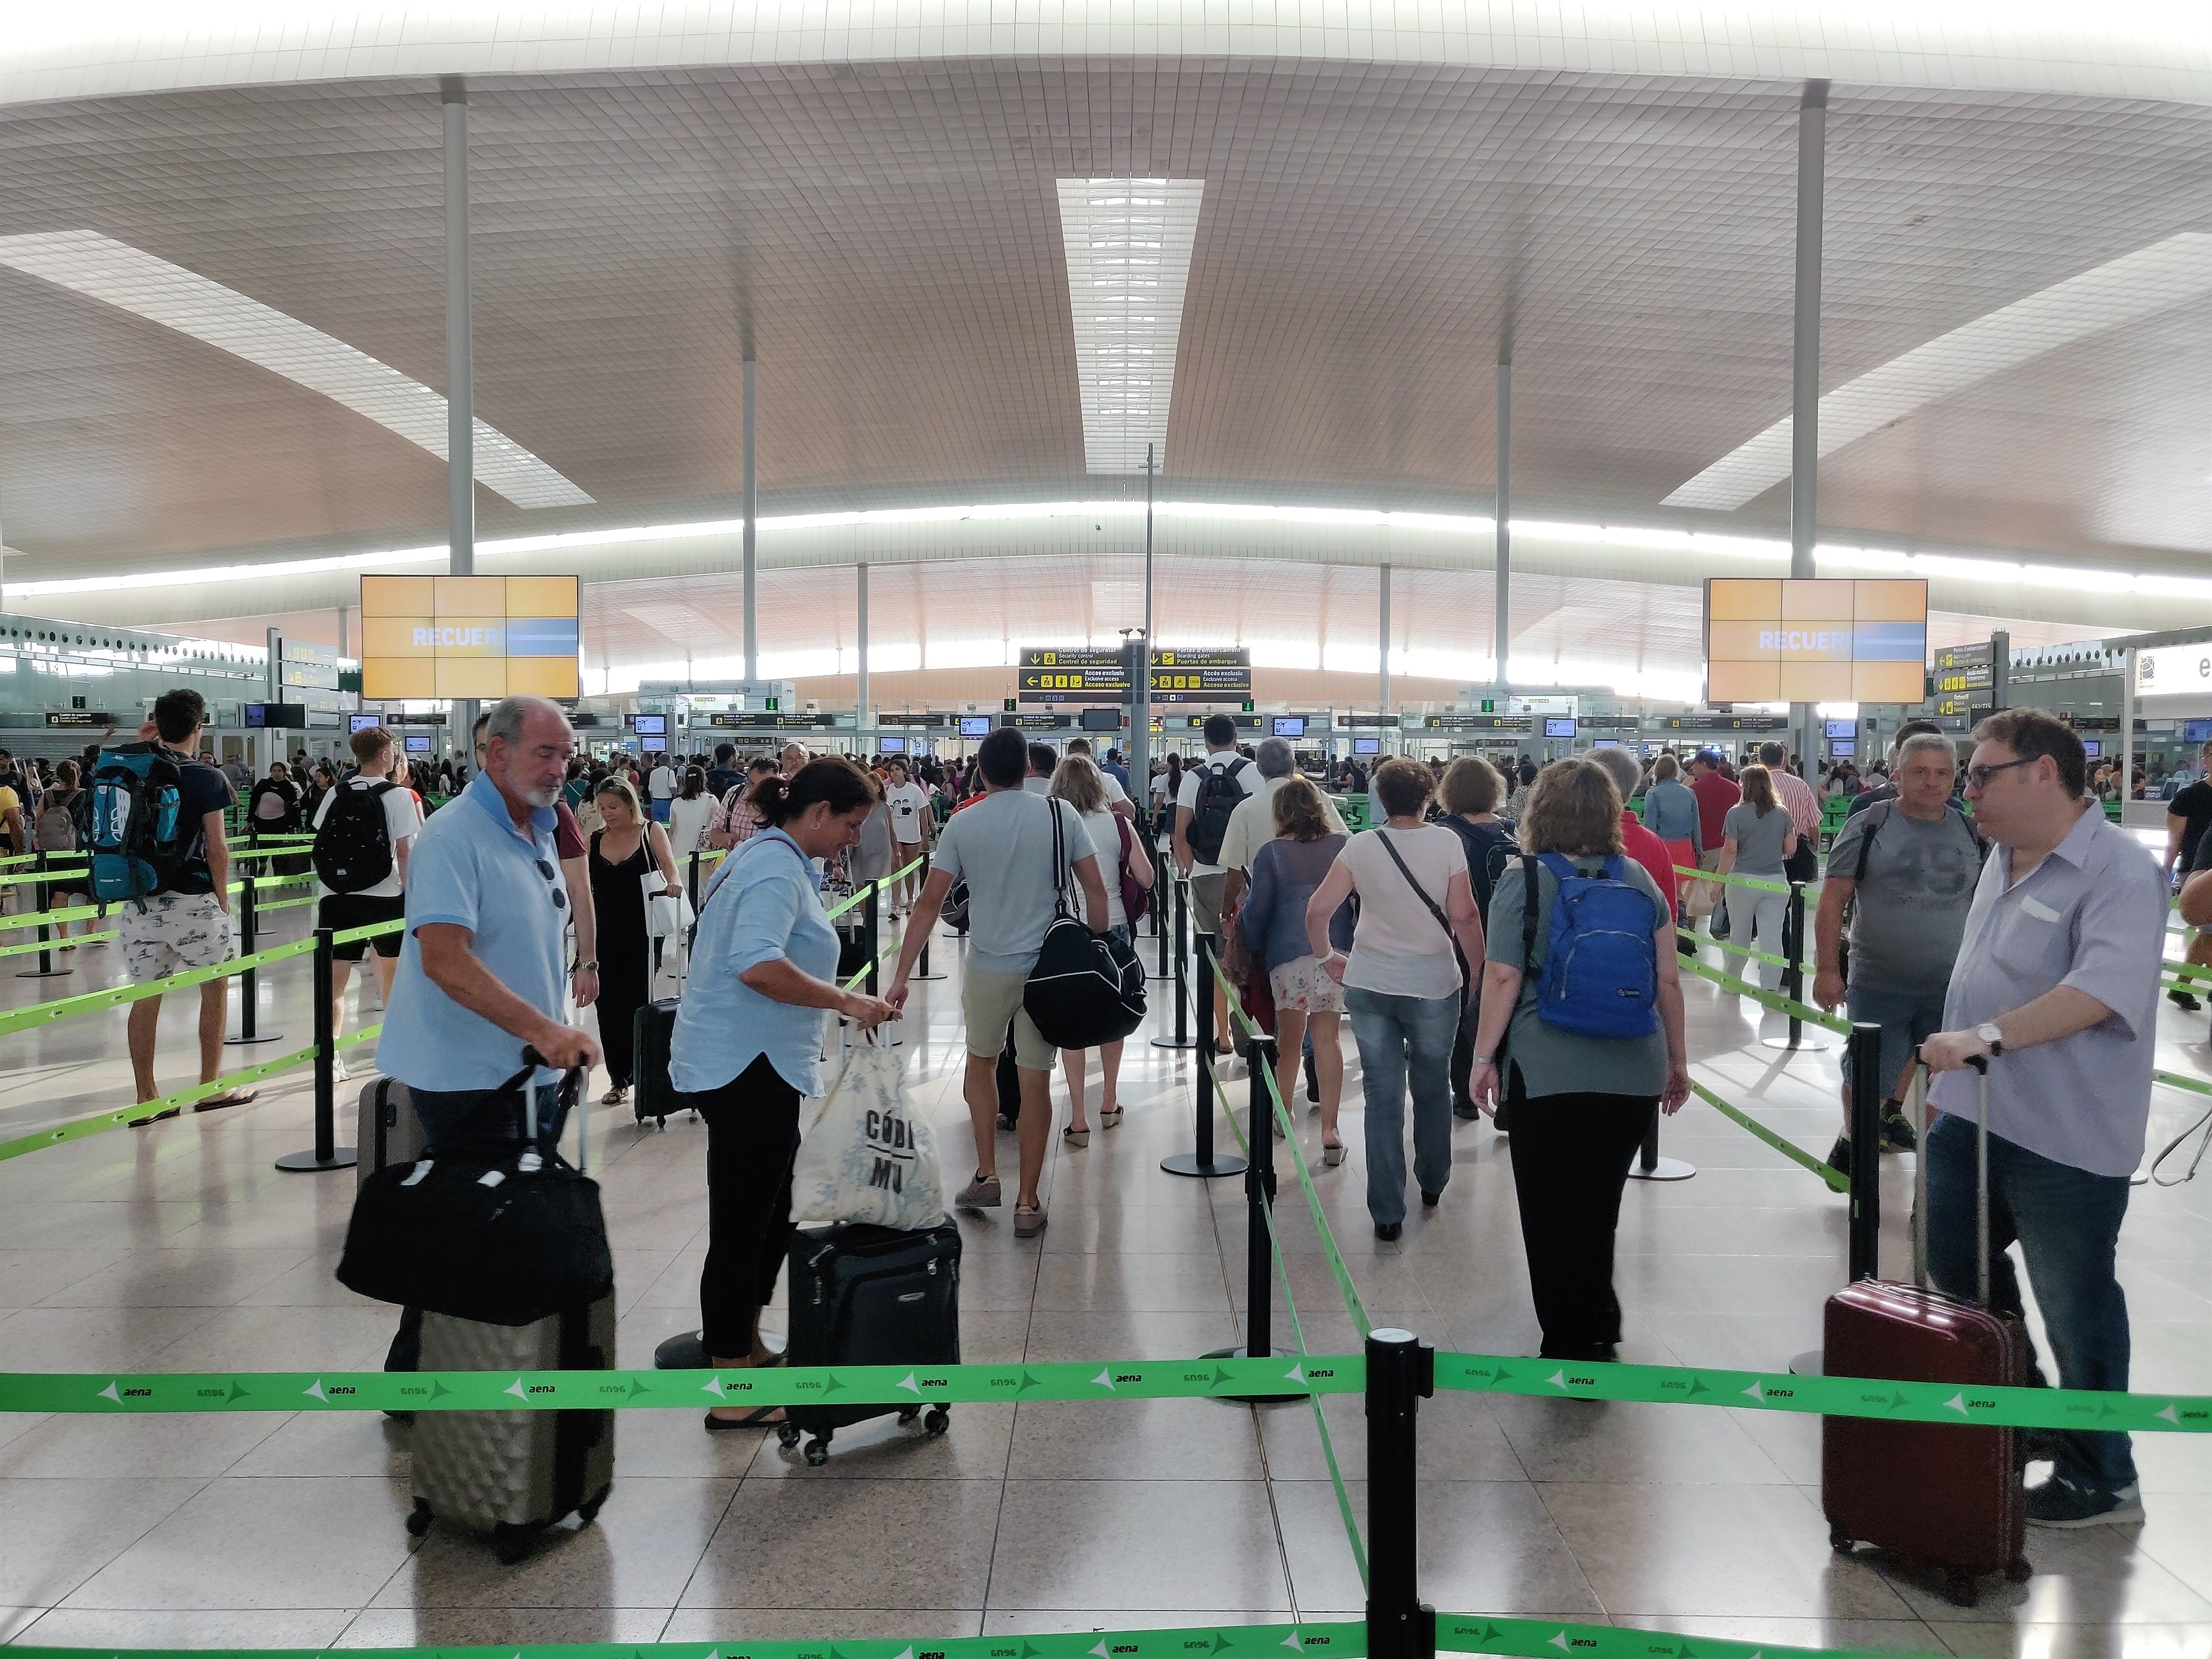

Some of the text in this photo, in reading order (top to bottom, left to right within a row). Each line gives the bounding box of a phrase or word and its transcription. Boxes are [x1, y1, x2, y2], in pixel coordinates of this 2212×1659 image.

[1116, 1374, 1142, 1383] aena
[1309, 1370, 1334, 1378] aena
[1569, 1377, 1595, 1386] aena
[124, 1389, 152, 1397] aena
[529, 1386, 556, 1394] aena
[1767, 1389, 1794, 1398] aena
[1969, 1400, 1996, 1409] aena
[1304, 1637, 1330, 1645] aena
[1571, 1639, 1597, 1648] aena
[1113, 1645, 1139, 1654] aena
